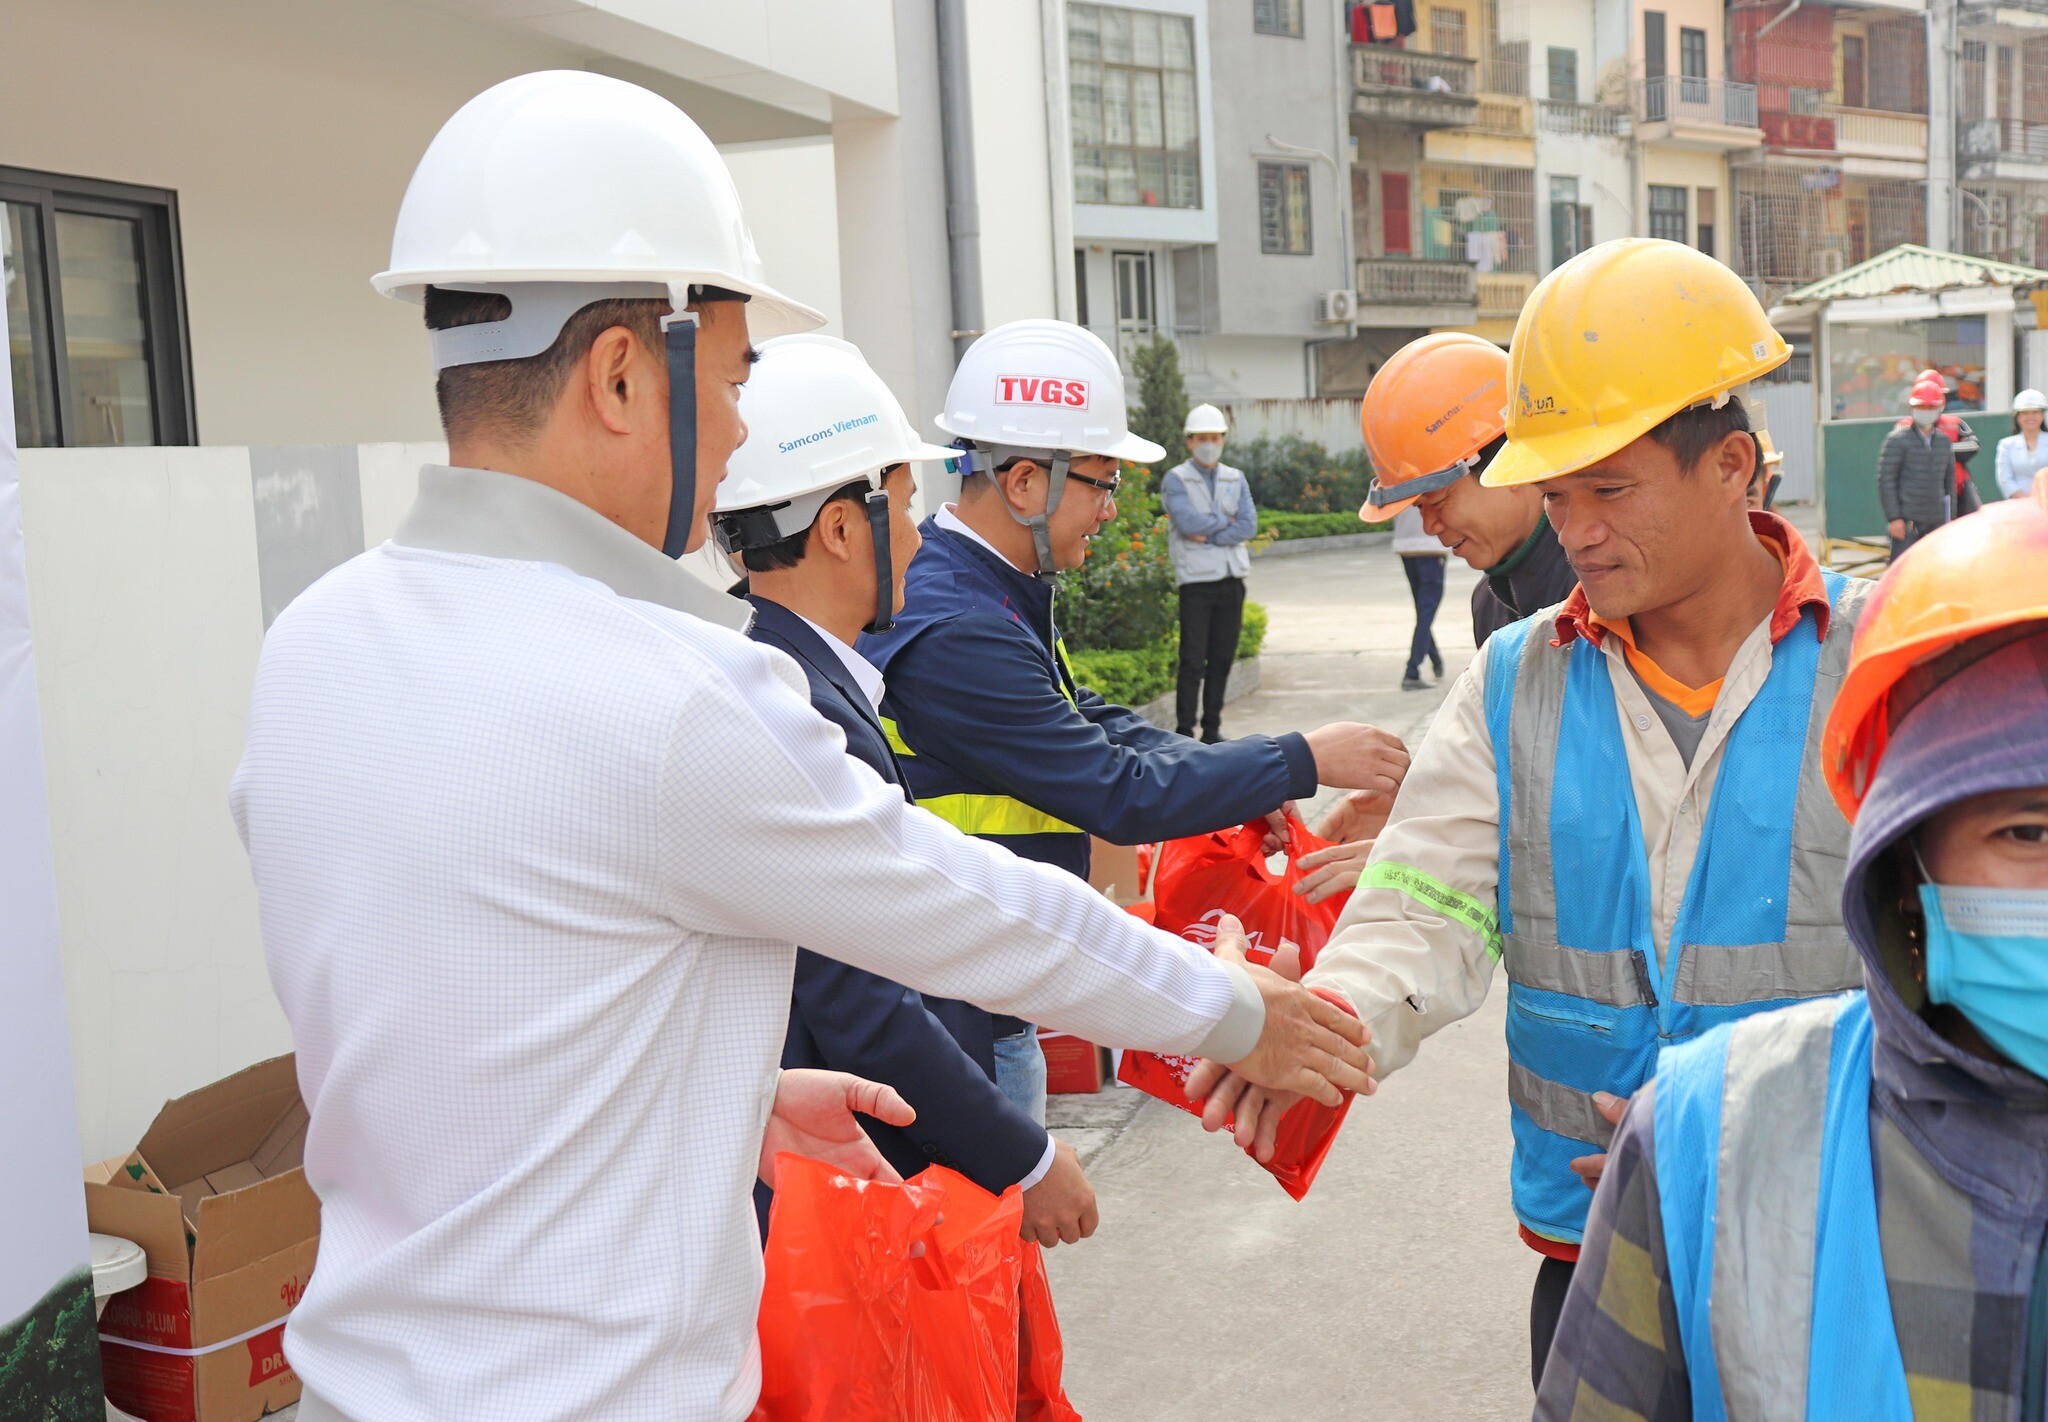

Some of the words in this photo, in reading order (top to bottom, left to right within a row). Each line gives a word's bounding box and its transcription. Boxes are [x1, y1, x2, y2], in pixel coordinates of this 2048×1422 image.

[1001, 378, 1085, 406] TVGS
[779, 428, 833, 453] Samcons
[833, 412, 878, 433] Vietnam
[146, 1310, 177, 1335] PLUM
